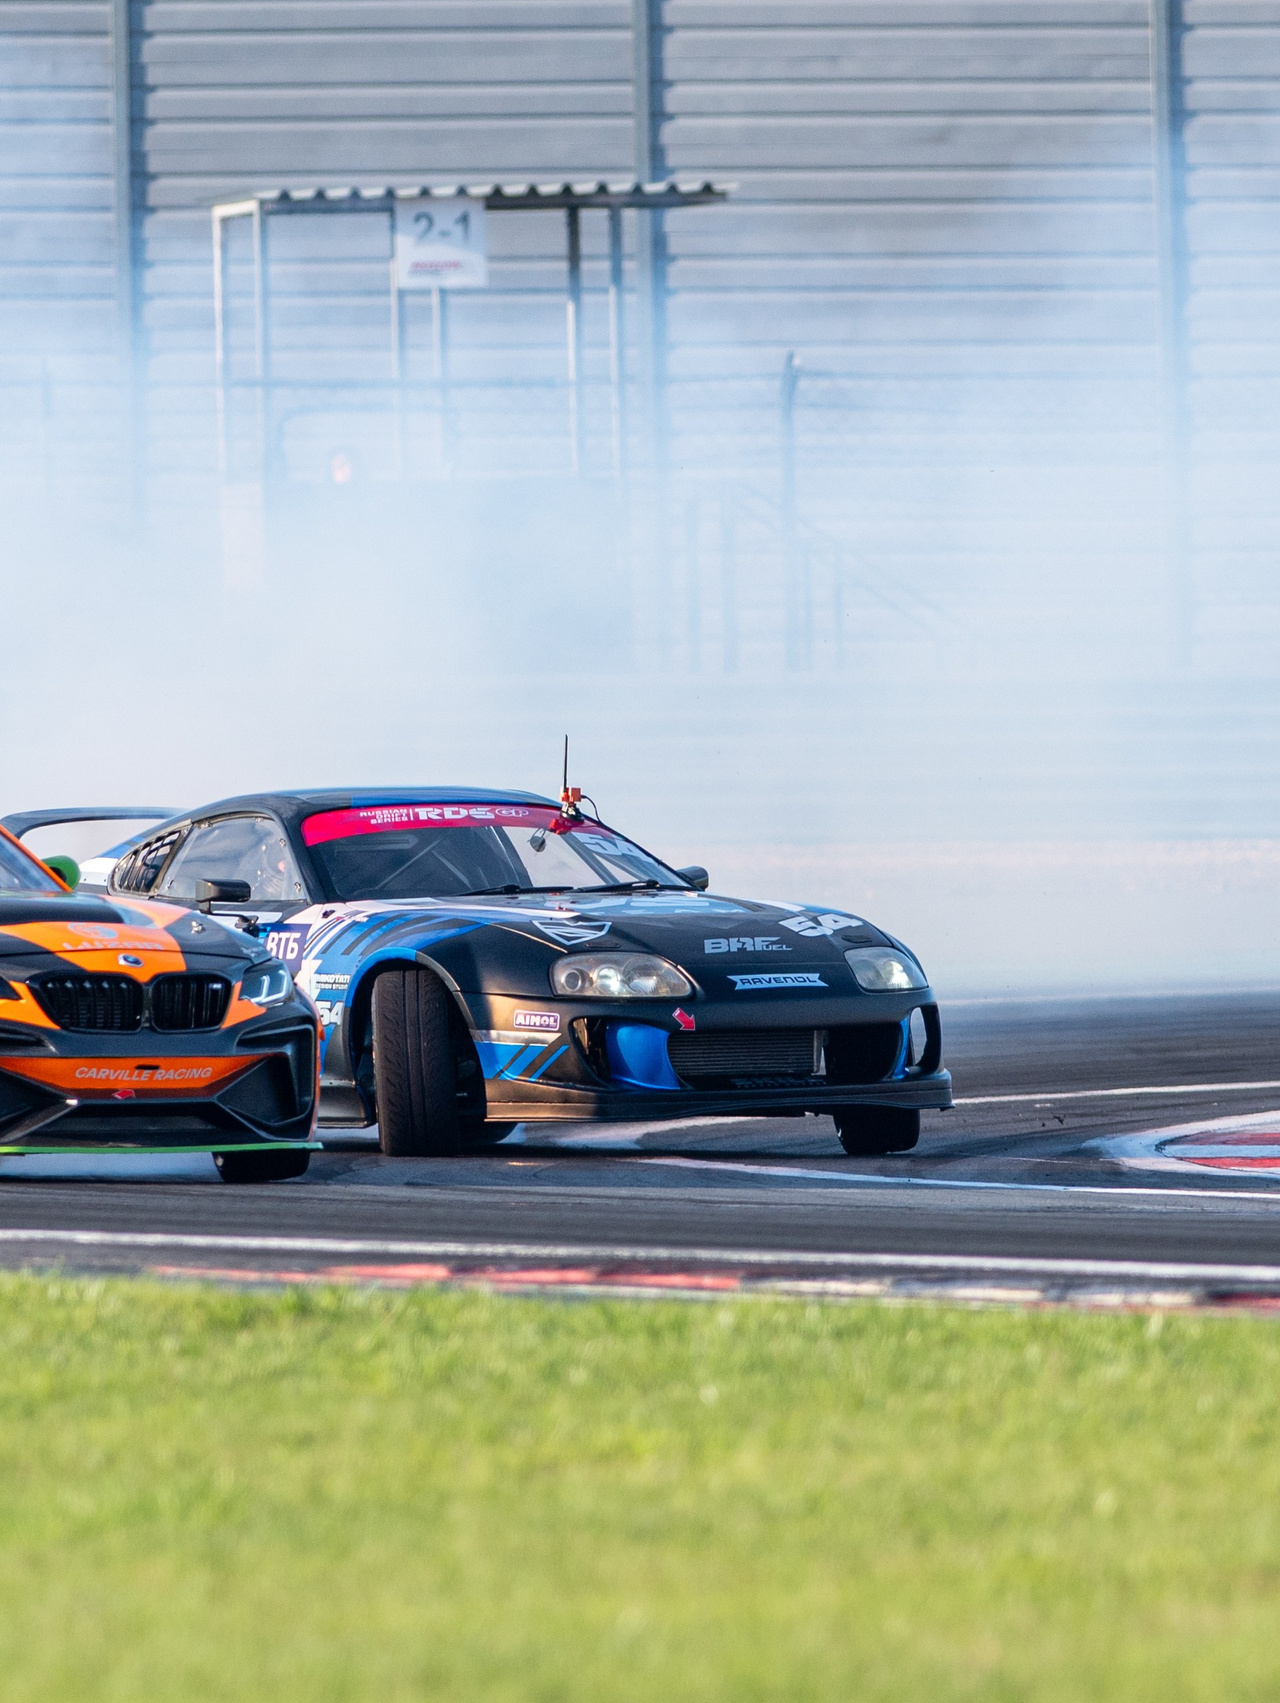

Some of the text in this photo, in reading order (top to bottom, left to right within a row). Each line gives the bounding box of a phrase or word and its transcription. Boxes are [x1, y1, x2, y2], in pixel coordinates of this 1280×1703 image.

[412, 210, 471, 242] 2-1
[359, 808, 408, 817] RUSSIAN
[376, 812, 408, 820] DRIFT
[414, 807, 495, 820] RDS
[370, 816, 409, 825] SERIES
[778, 913, 864, 937] 54
[61, 941, 165, 951] LUZAR
[266, 931, 302, 960] ВТБ
[740, 976, 818, 987] RAVENOL
[315, 1001, 344, 1026] 54
[515, 1014, 557, 1027] AIMOL
[74, 1066, 213, 1082] CARVILLE RACING
